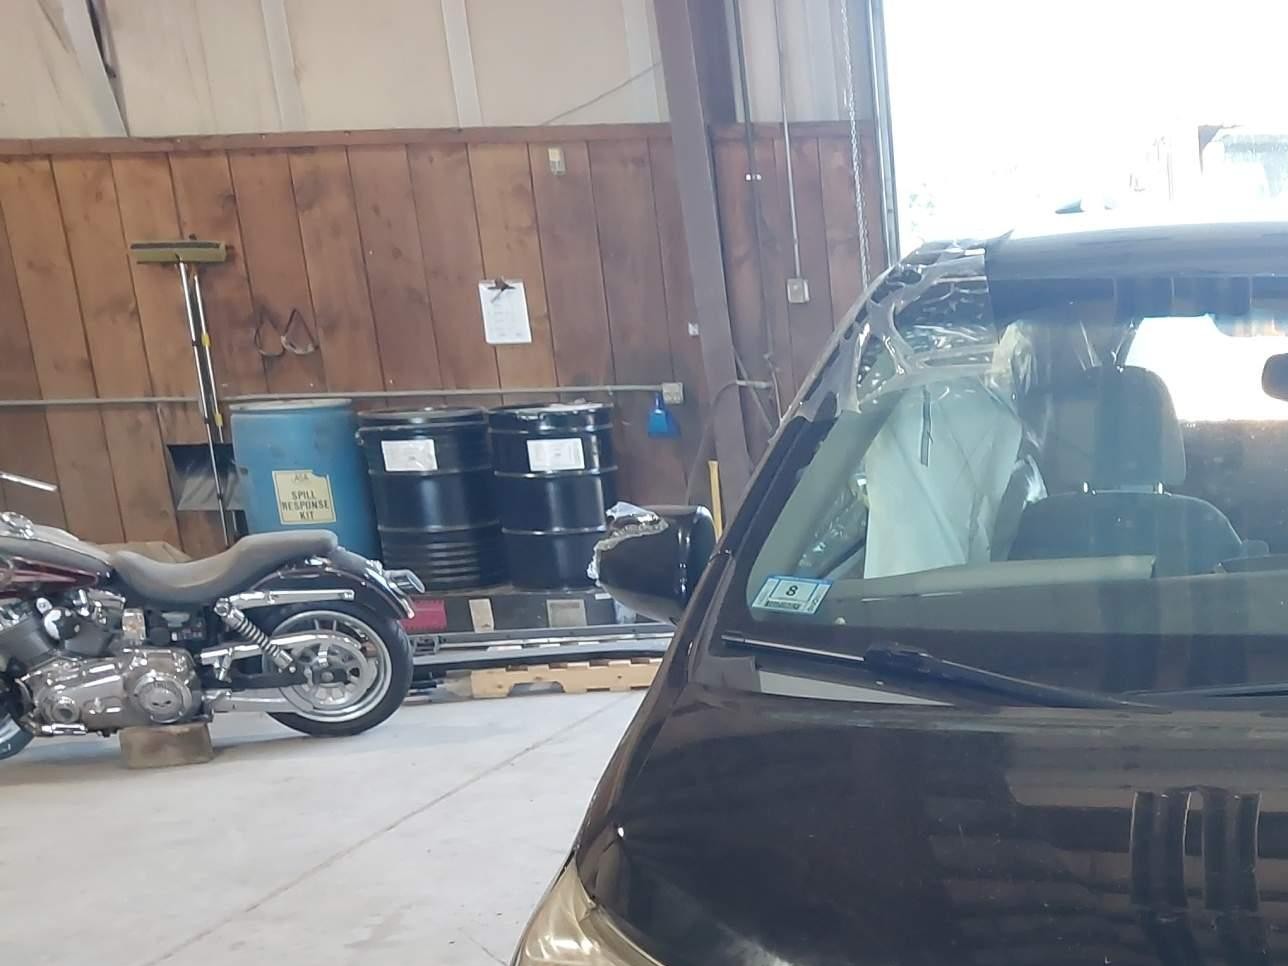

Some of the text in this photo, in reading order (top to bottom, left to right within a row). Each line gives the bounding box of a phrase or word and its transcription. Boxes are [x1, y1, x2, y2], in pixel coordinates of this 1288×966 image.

[291, 490, 316, 500] SPILL
[281, 499, 330, 511] RESPONSE
[299, 511, 314, 520] KIT
[786, 585, 798, 596] 8
